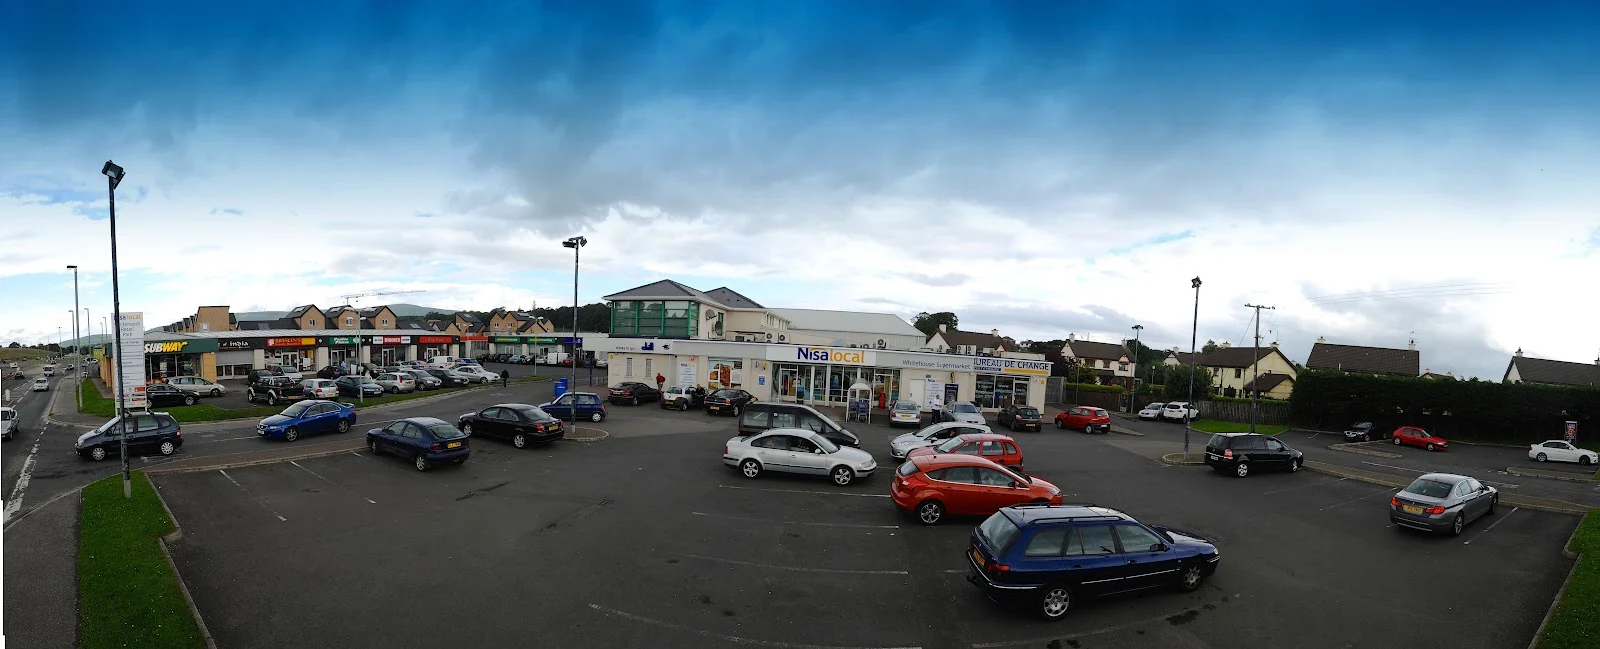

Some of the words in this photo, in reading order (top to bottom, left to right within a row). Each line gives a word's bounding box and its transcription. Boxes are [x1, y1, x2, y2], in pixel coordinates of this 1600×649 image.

[144, 341, 188, 353] SUBWAY
[902, 360, 935, 368] Whitehouse
[936, 361, 971, 370] Supermarket
[1004, 360, 1016, 368] DE
[1017, 361, 1049, 371] CHANGE
